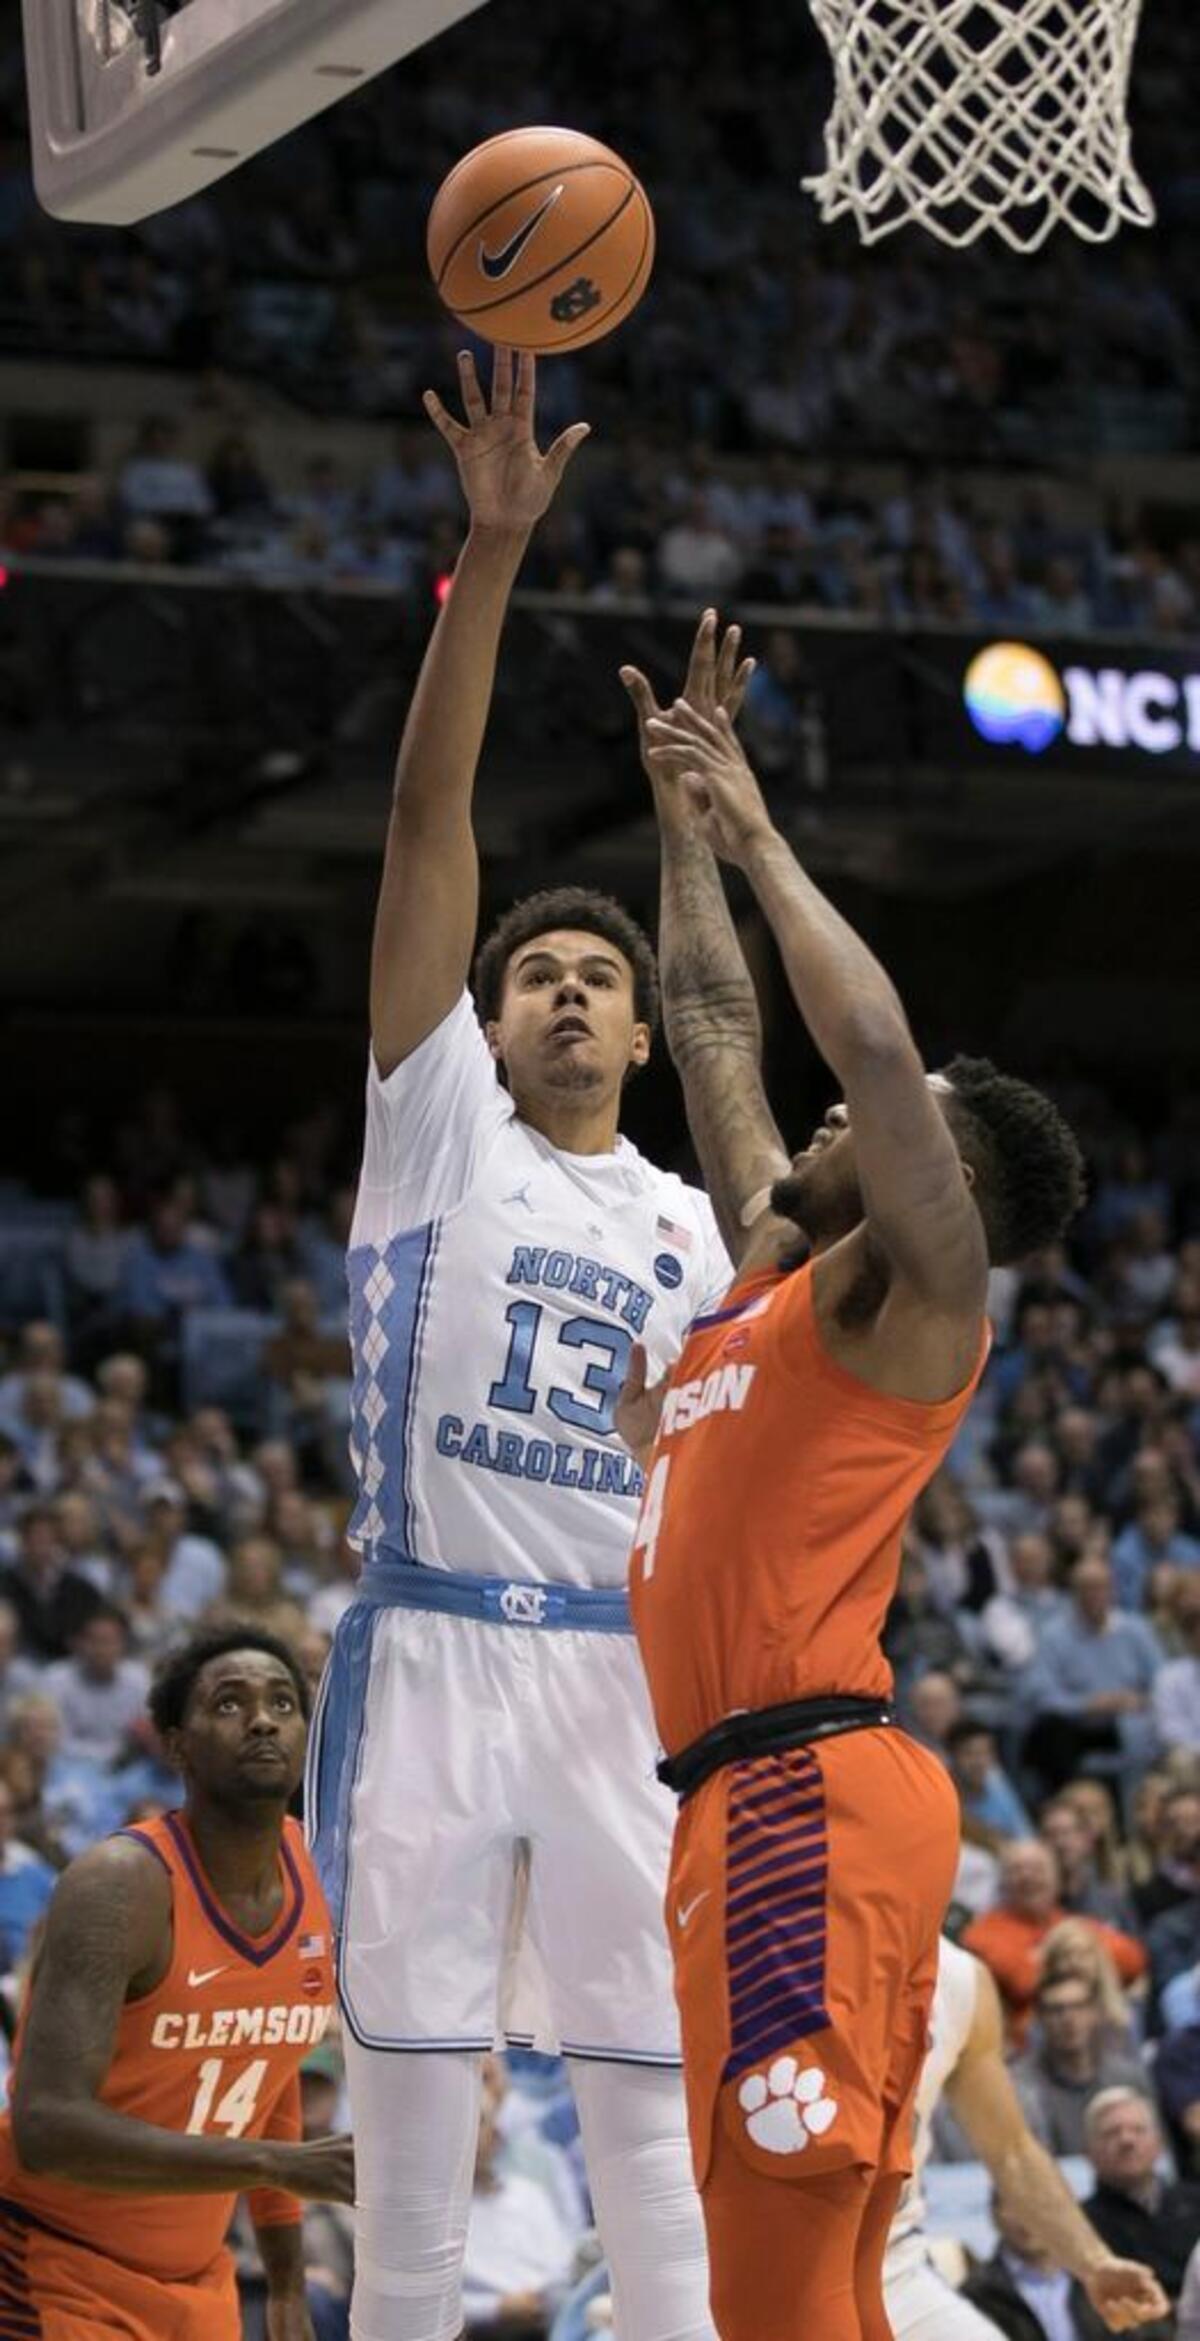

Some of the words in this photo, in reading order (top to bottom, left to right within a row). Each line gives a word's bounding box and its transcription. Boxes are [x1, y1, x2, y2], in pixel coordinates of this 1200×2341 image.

[1063, 666, 1182, 753] NC
[506, 1246, 654, 1334] NORTH
[488, 1299, 635, 1436] 13
[436, 1414, 645, 1497] CAROLINA
[151, 2003, 333, 2050] CLEMSON
[185, 2056, 269, 2139] 14
